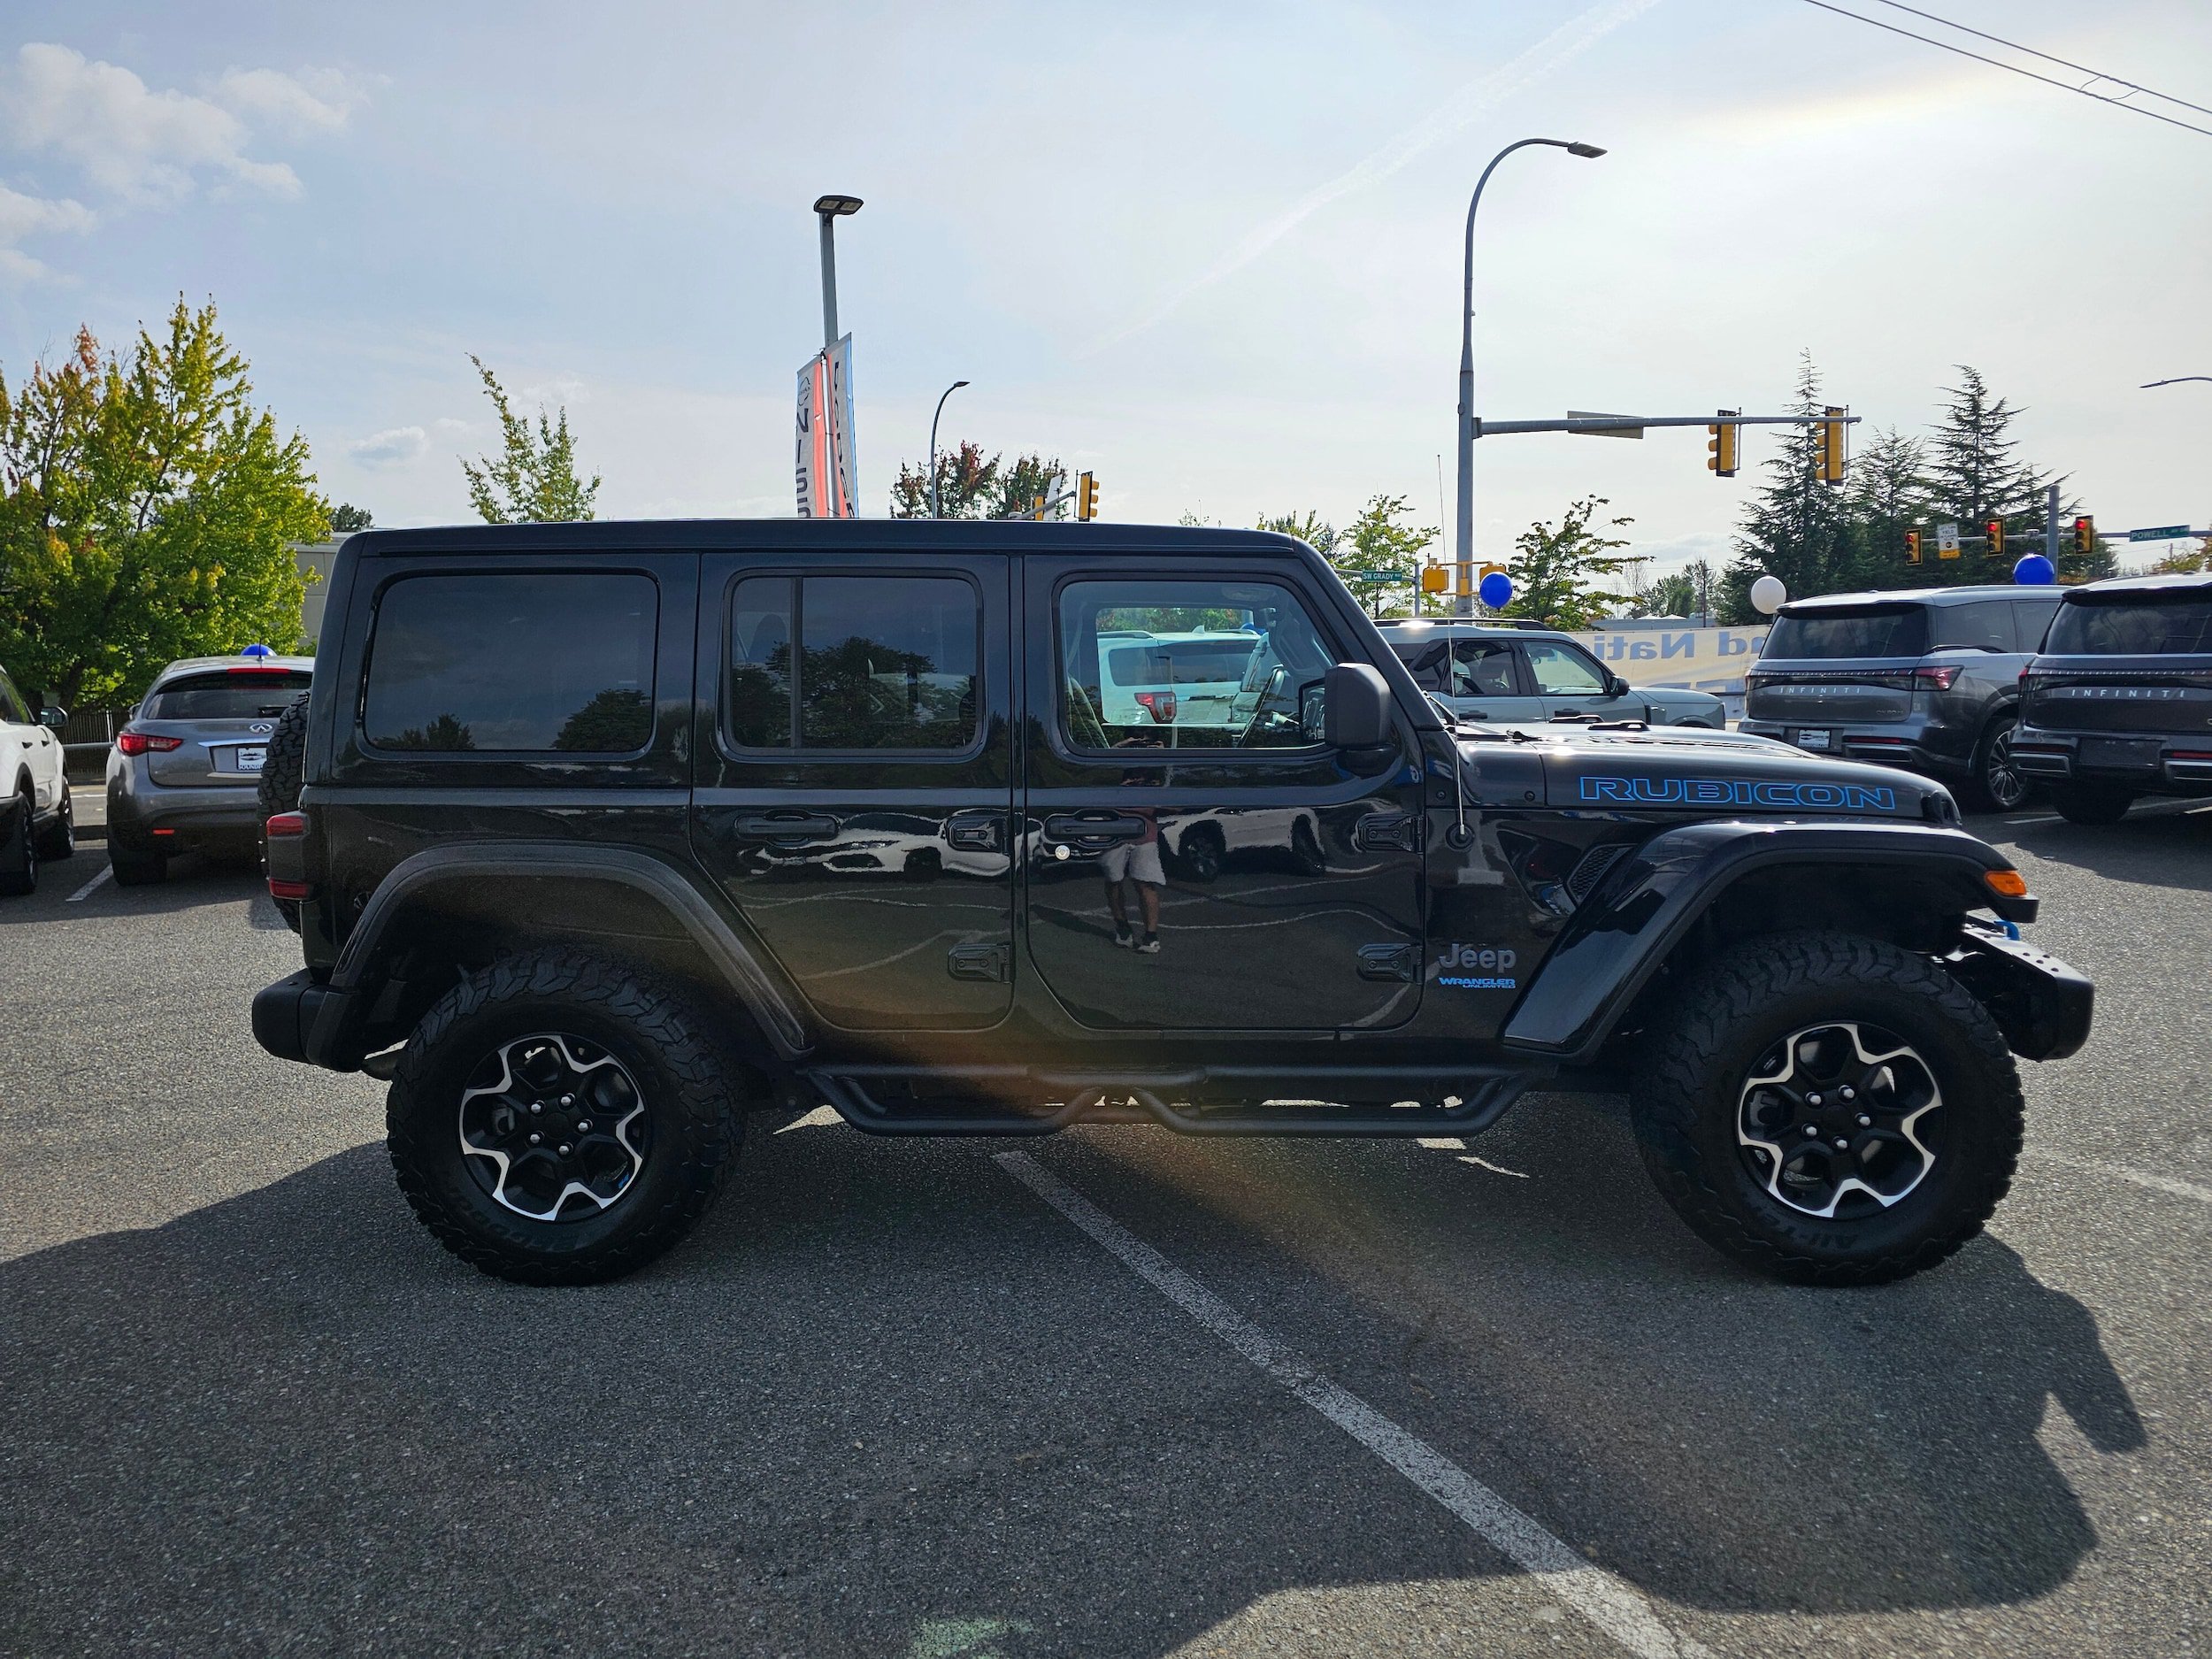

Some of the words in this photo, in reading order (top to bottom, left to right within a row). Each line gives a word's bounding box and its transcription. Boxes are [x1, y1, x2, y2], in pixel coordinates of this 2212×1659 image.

[2131, 531, 2170, 540] POWELL
[2071, 688, 2185, 698] INFINITI
[1579, 776, 1895, 810] RUBICON
[1439, 943, 1517, 973] Jeep
